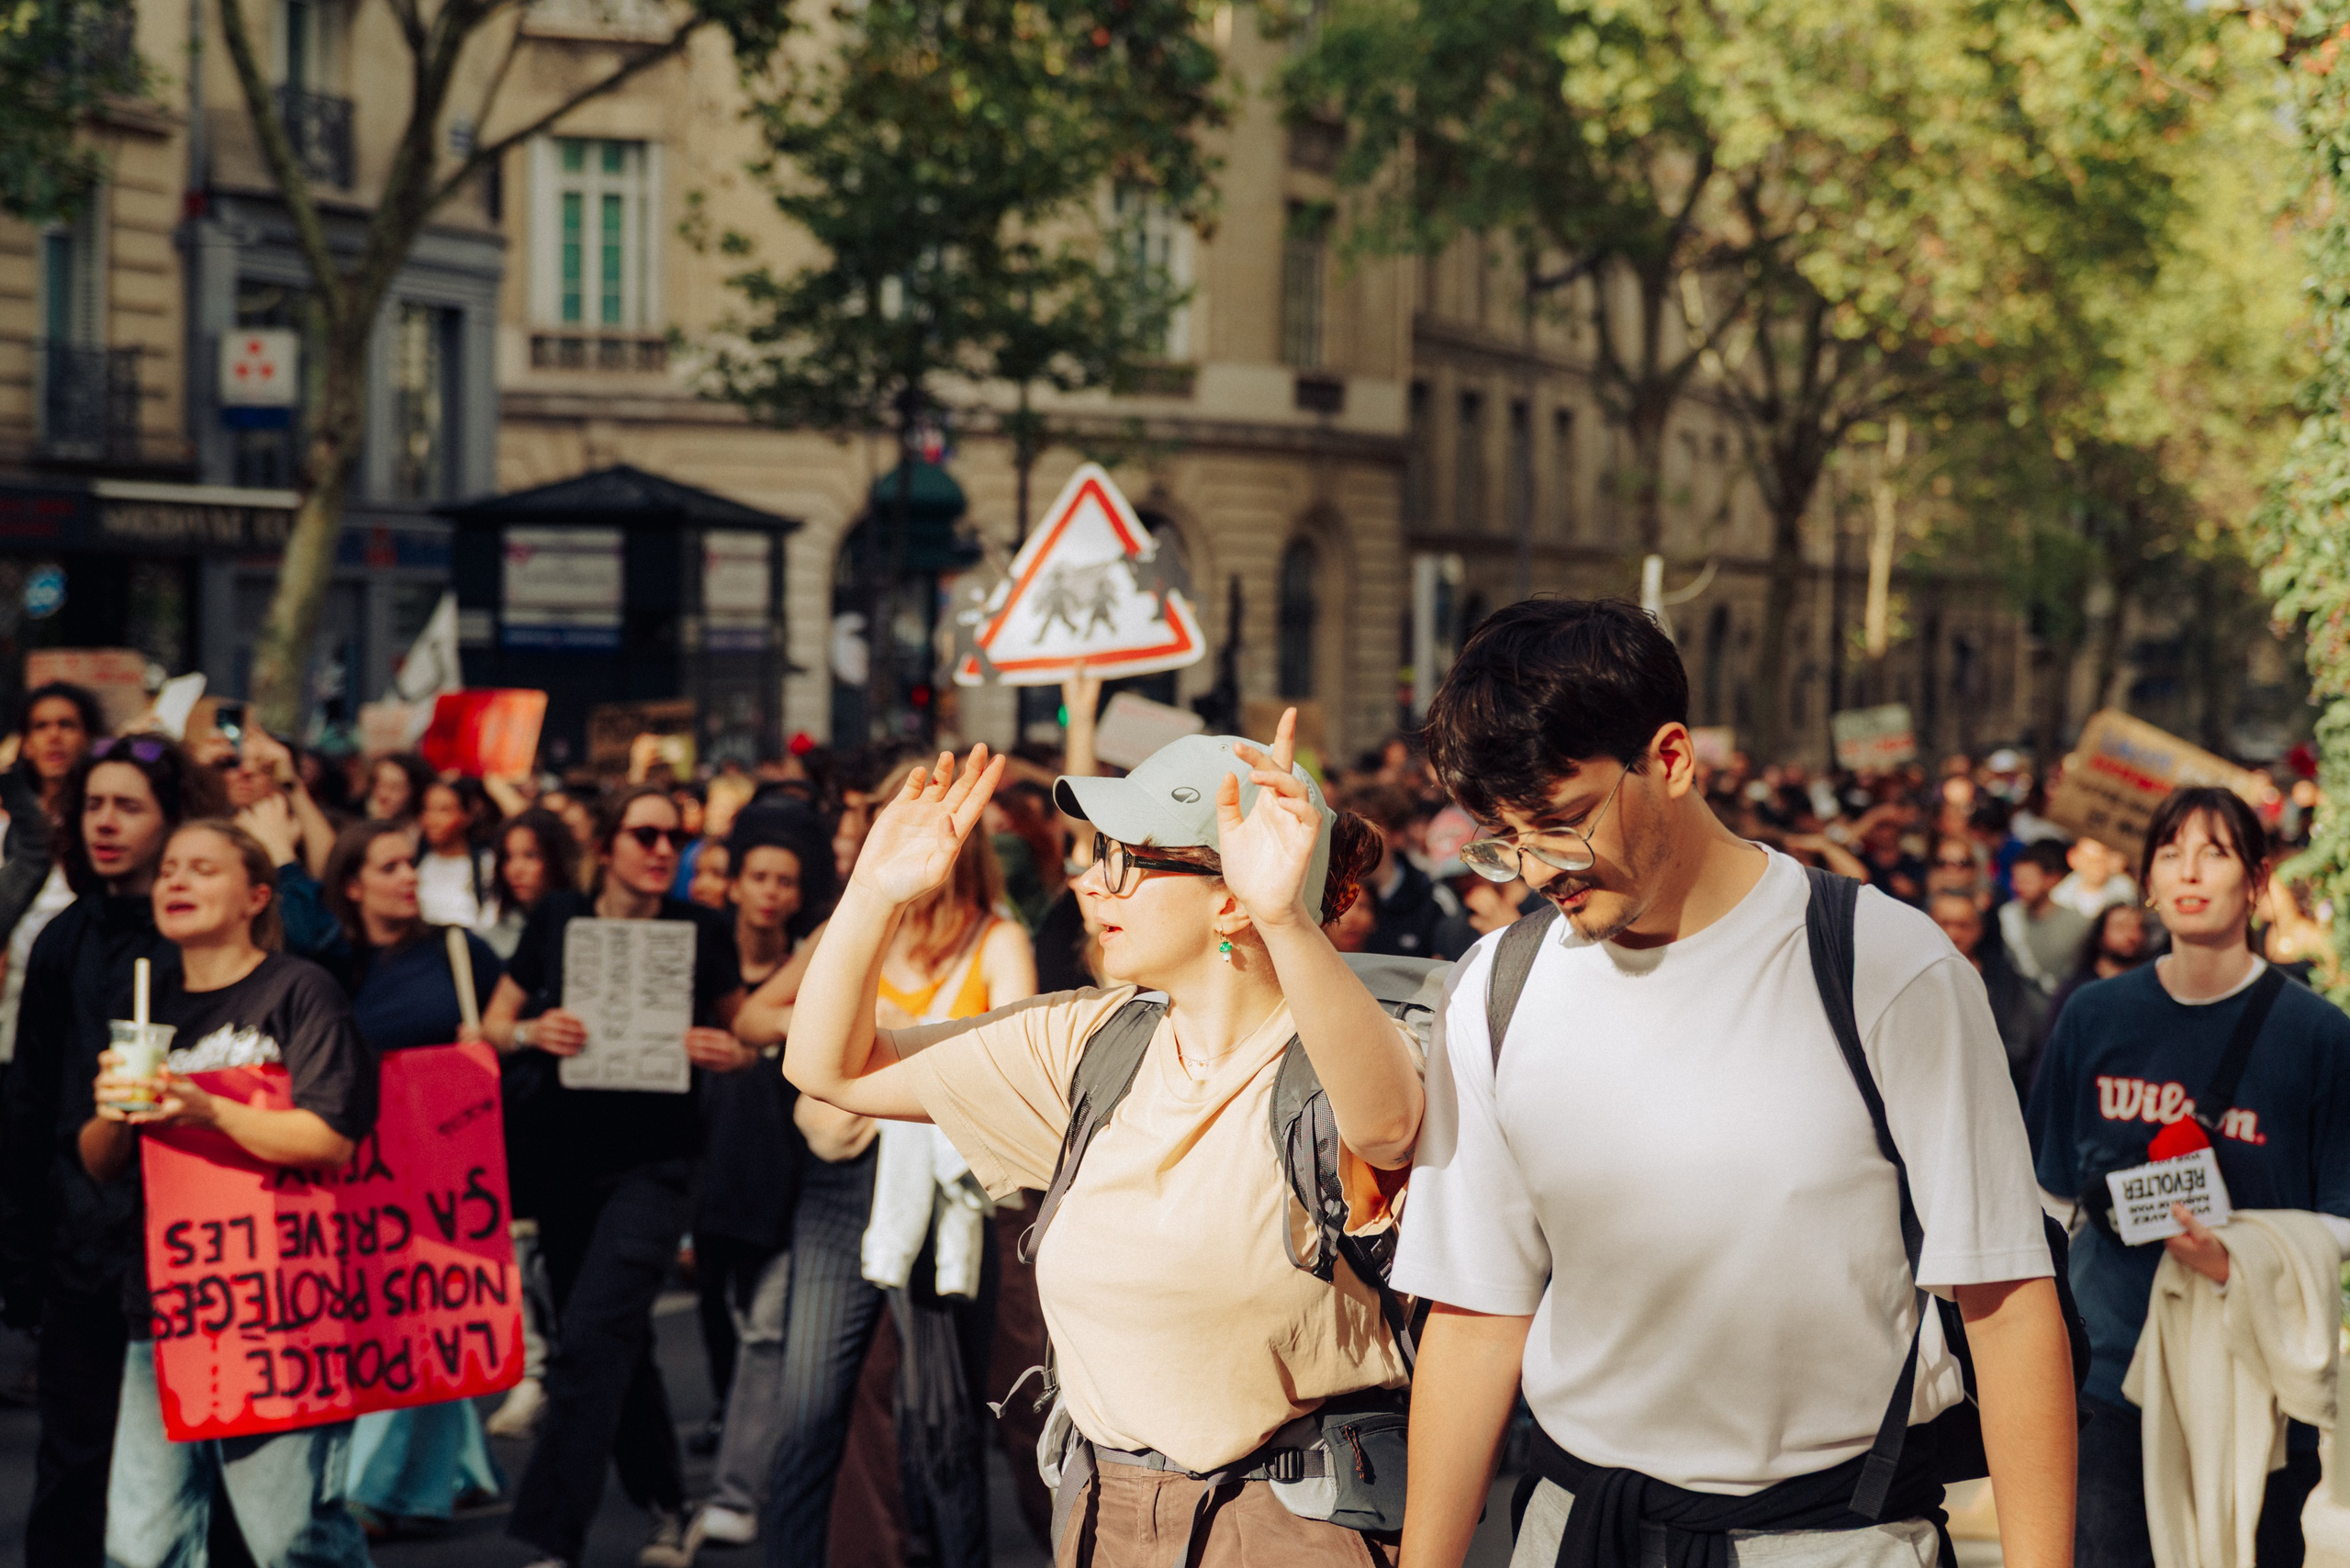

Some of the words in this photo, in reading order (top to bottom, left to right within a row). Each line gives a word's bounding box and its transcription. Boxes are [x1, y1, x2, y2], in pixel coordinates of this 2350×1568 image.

[2096, 1075, 2258, 1144] Wiln
[427, 1166, 500, 1242] ÇA
[2122, 1167, 2205, 1200] RÉVOLTER
[166, 1215, 257, 1266] LES
[384, 1262, 508, 1316] NOUS
[246, 1338, 414, 1400] POLICE
[435, 1321, 497, 1375] LA
